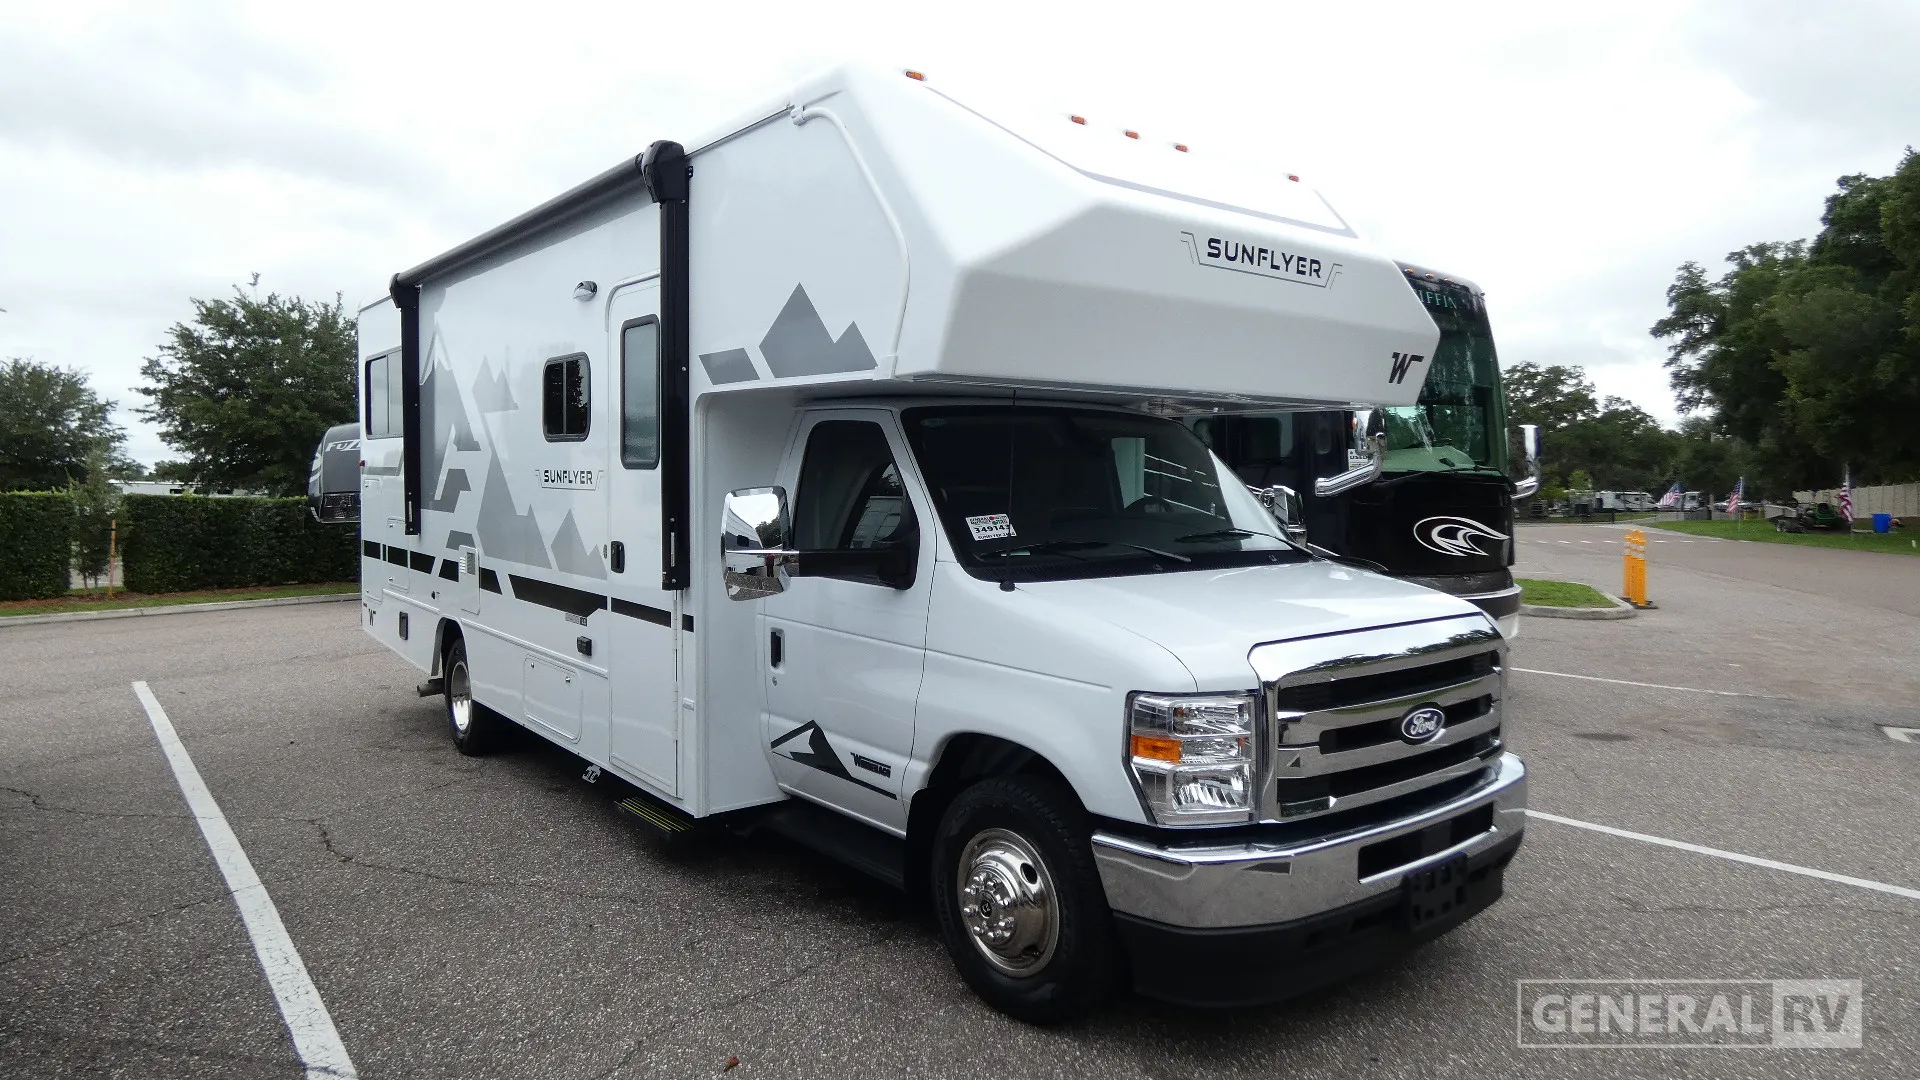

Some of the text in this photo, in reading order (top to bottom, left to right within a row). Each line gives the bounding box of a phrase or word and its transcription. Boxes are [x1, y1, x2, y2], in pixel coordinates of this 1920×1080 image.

[1207, 237, 1322, 279] SUNFLYER
[1413, 289, 1457, 310] IFFIN
[543, 469, 593, 485] SUNFLYER
[1410, 712, 1438, 735] Ford
